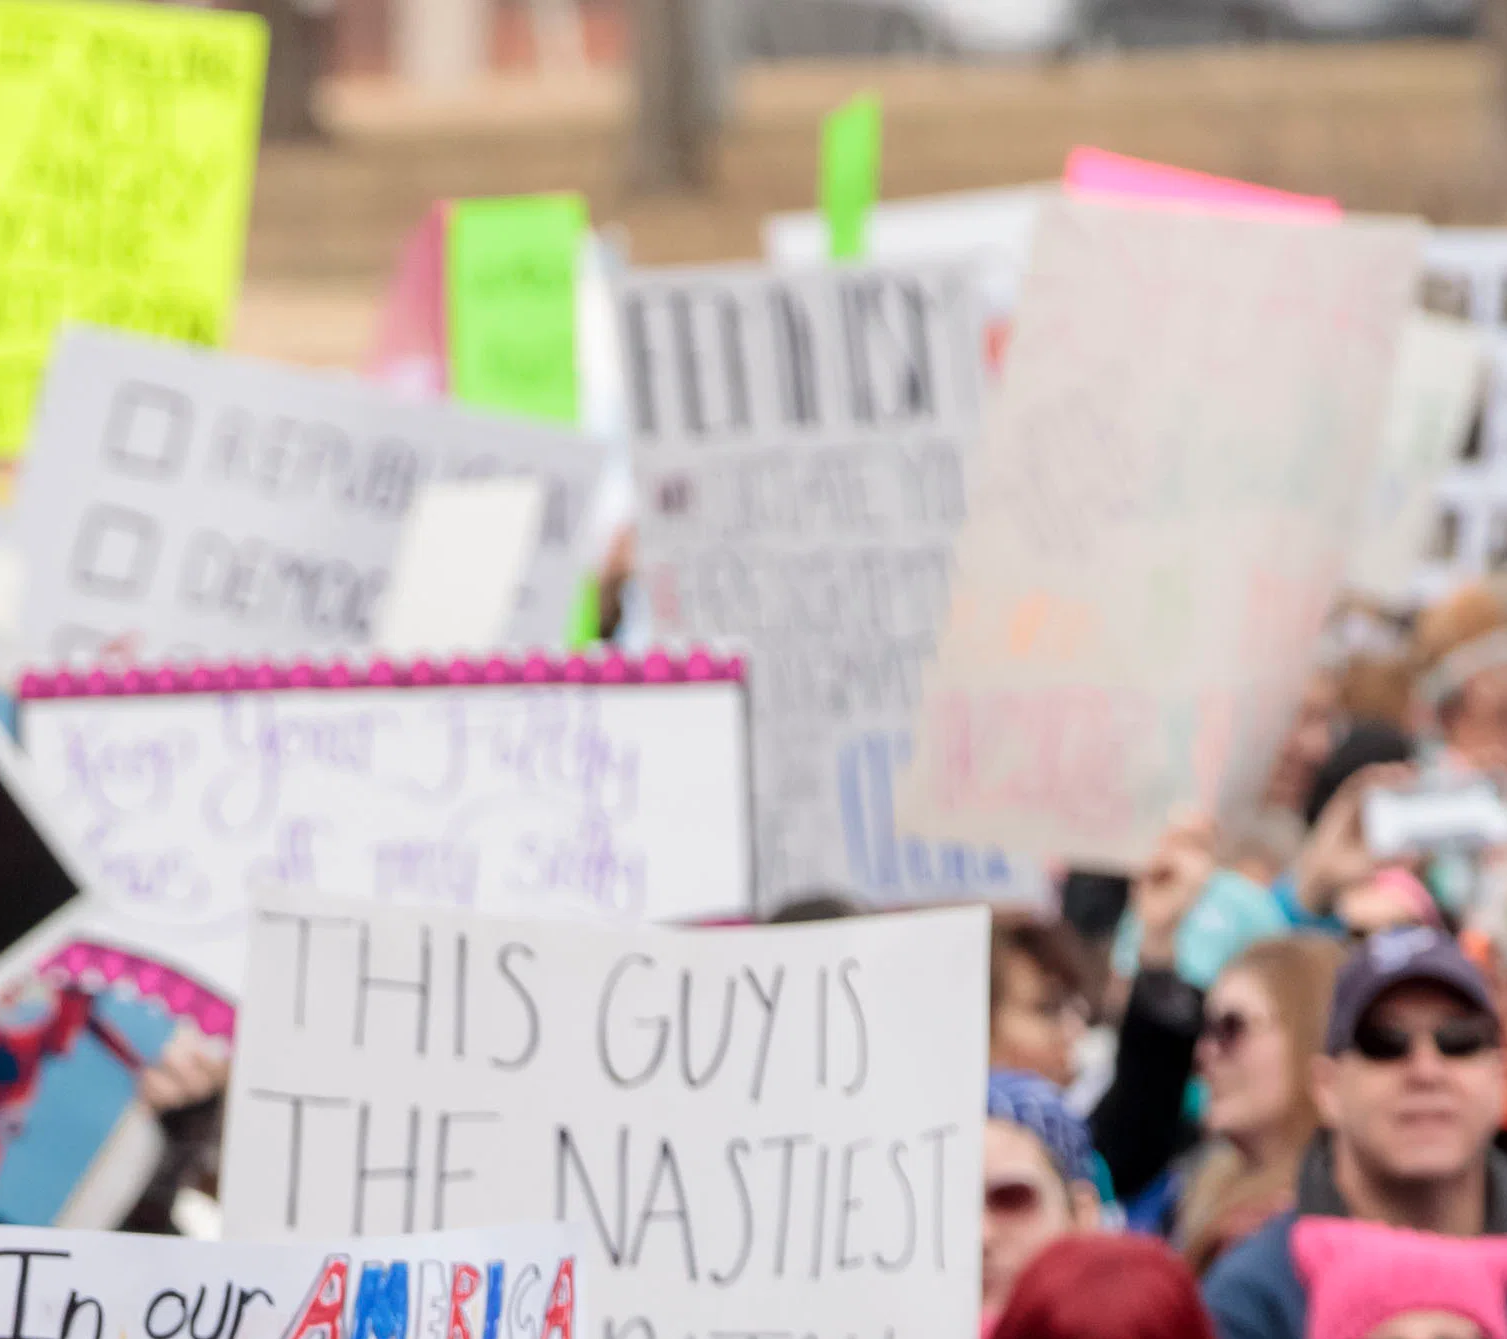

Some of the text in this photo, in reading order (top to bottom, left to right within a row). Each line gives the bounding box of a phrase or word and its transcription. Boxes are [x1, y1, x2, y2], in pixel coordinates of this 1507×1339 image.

[257, 910, 870, 1103] THIS GUY IS
[554, 1121, 961, 1287] NASTIEST
